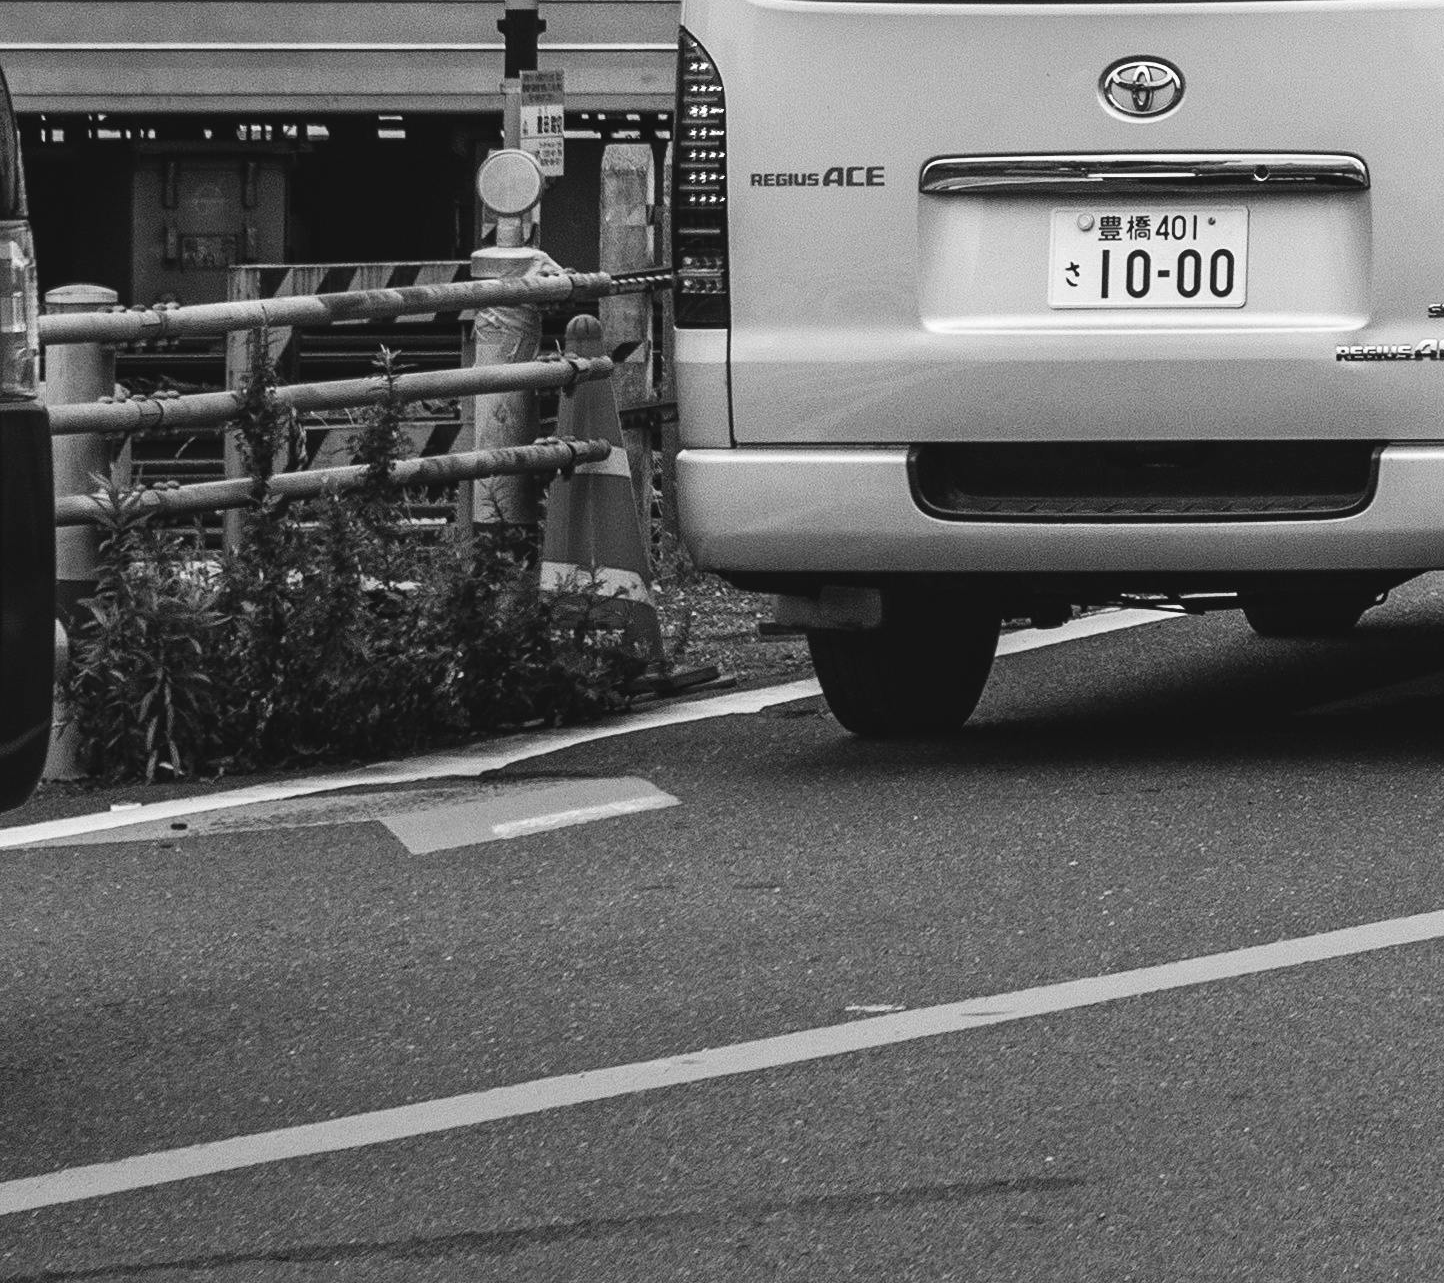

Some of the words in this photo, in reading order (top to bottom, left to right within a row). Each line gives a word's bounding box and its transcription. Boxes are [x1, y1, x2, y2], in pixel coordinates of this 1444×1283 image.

[750, 173, 820, 187] REGIUS
[822, 166, 886, 187] ACE
[1064, 261, 1081, 287] さ
[1100, 248, 1235, 299] 10-00
[1335, 344, 1413, 362] REGIUS
